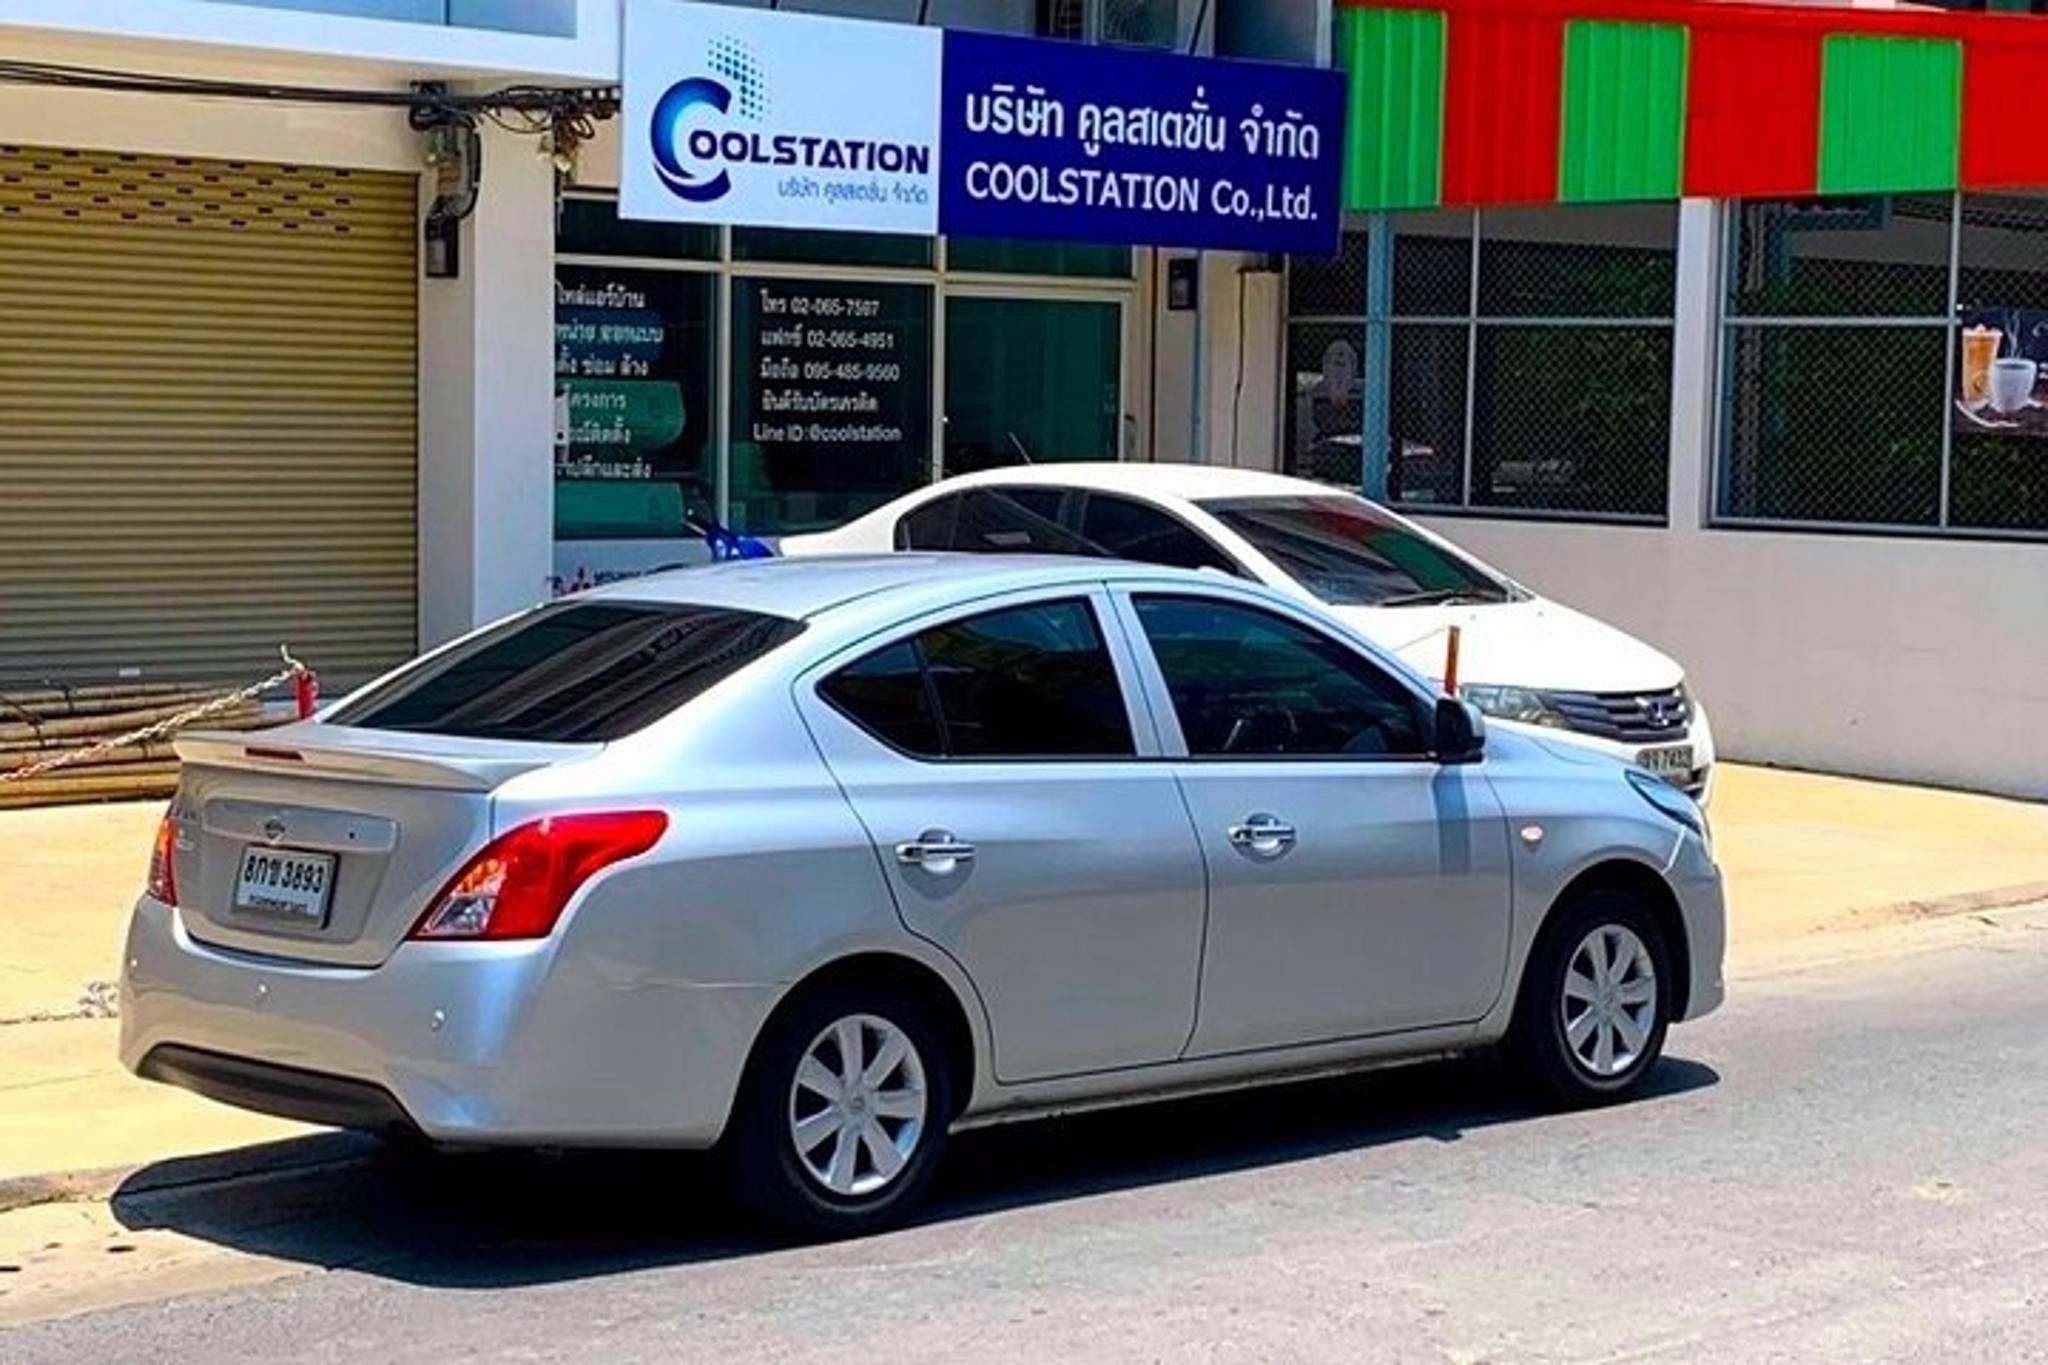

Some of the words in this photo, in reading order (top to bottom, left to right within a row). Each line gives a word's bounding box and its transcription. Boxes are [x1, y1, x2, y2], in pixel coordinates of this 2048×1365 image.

[966, 84, 1064, 138] บริษัท
[1078, 86, 1226, 157] คูลสเตชั่น
[1239, 104, 1320, 160] จำกัด
[966, 161, 1200, 213] COOLSTATION
[1211, 180, 1319, 222] Co.,Ltd.
